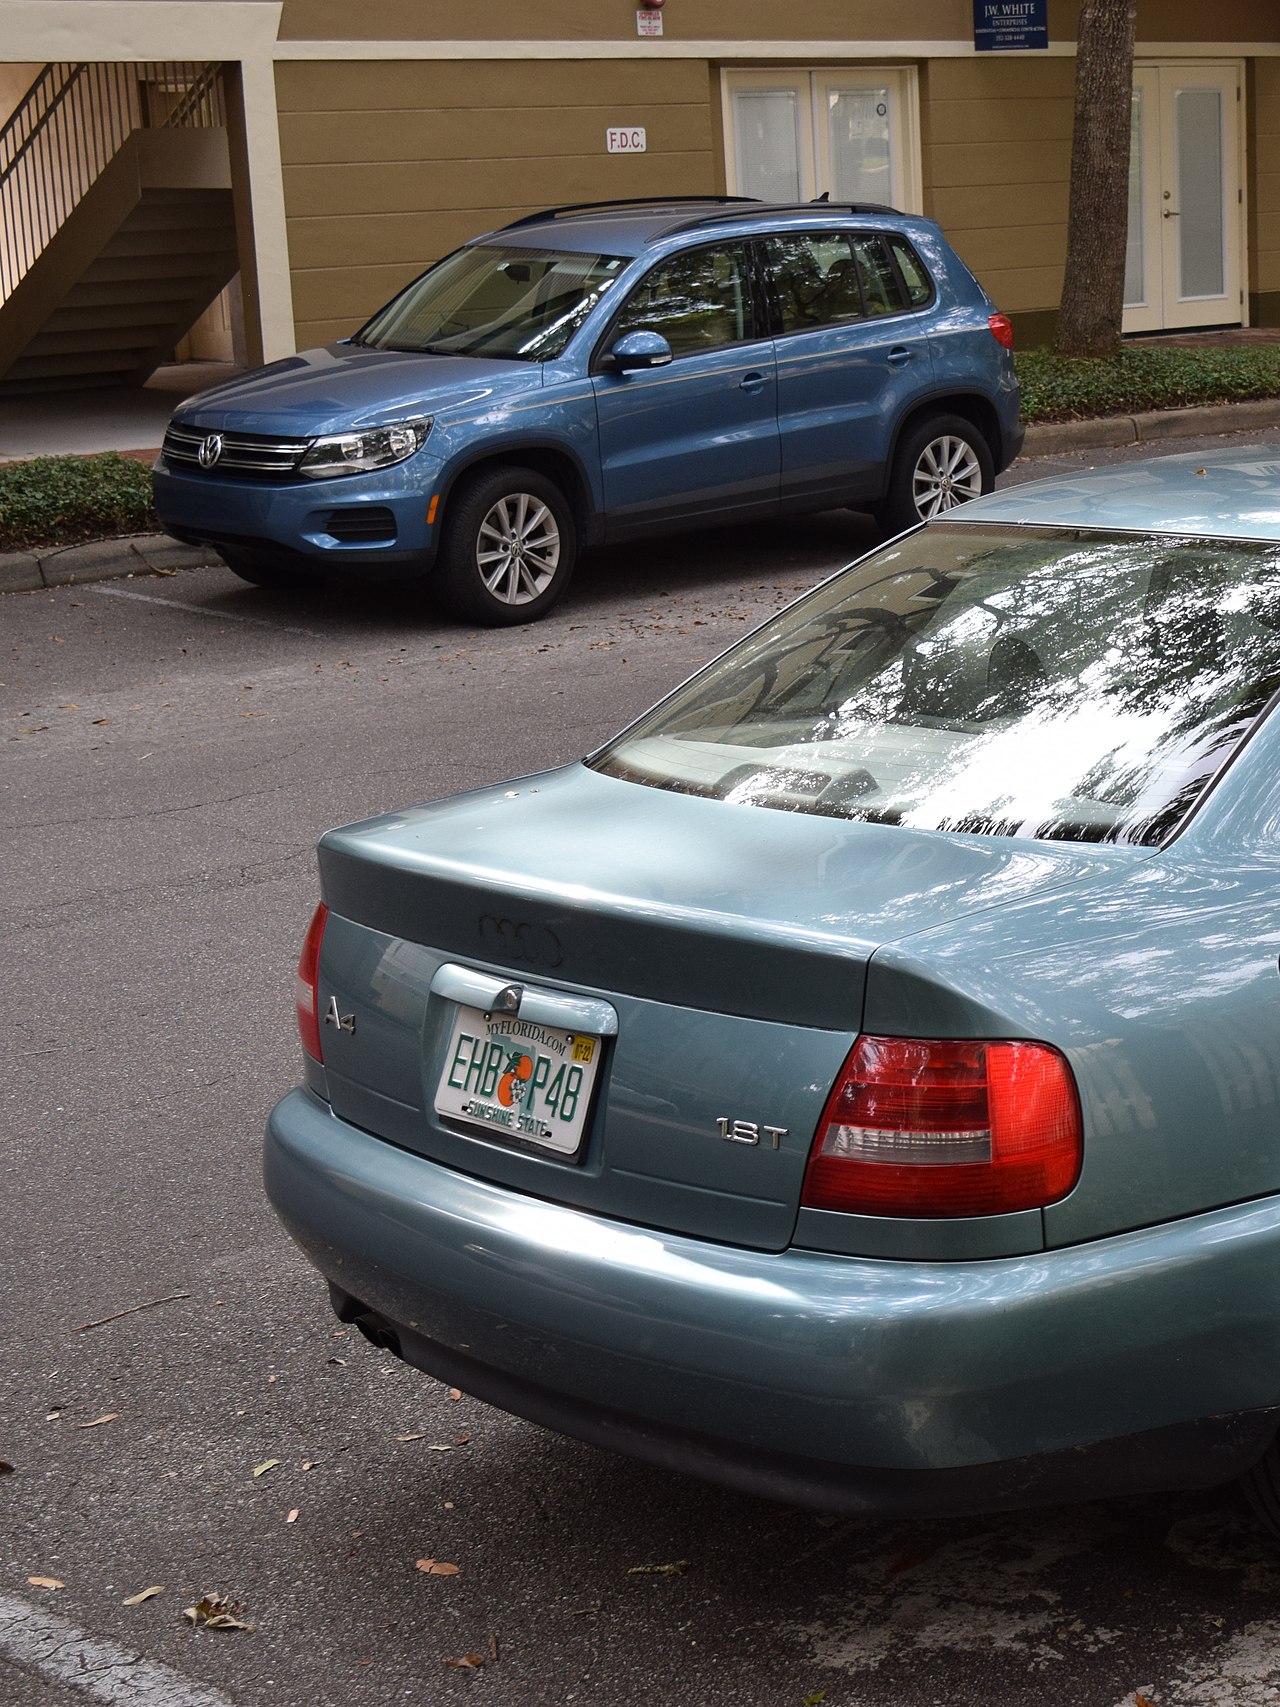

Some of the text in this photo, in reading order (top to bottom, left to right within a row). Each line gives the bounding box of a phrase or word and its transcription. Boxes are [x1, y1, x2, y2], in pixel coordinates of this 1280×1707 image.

[992, 18, 1028, 26] ENTERPRISES
[1002, 3, 1036, 15] WHITE
[609, 131, 644, 149] F.D.C.
[325, 995, 356, 1036] A4
[486, 1020, 567, 1056] MYFLORIDA.COM
[448, 1033, 584, 1122] EHB P48
[466, 1098, 548, 1138] SUNSHINE STATE
